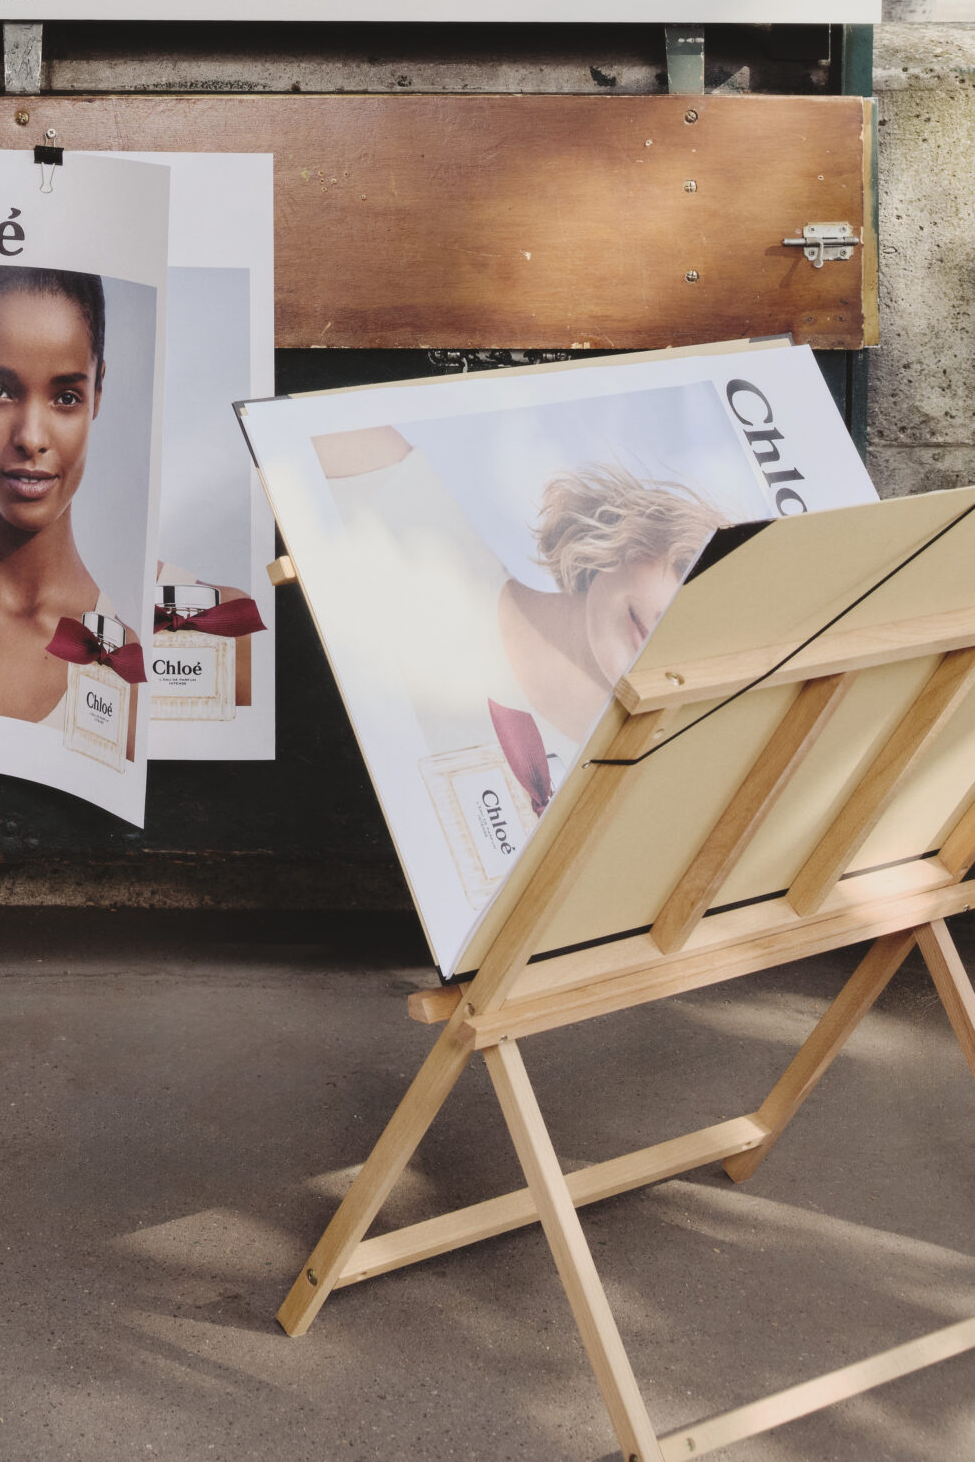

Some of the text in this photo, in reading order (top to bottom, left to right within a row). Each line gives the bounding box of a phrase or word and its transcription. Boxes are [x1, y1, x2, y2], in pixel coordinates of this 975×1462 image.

[726, 378, 808, 517] Chlo
[152, 659, 203, 676] Chloé
[86, 691, 113, 718] Chloé
[481, 789, 516, 855] Chloé
